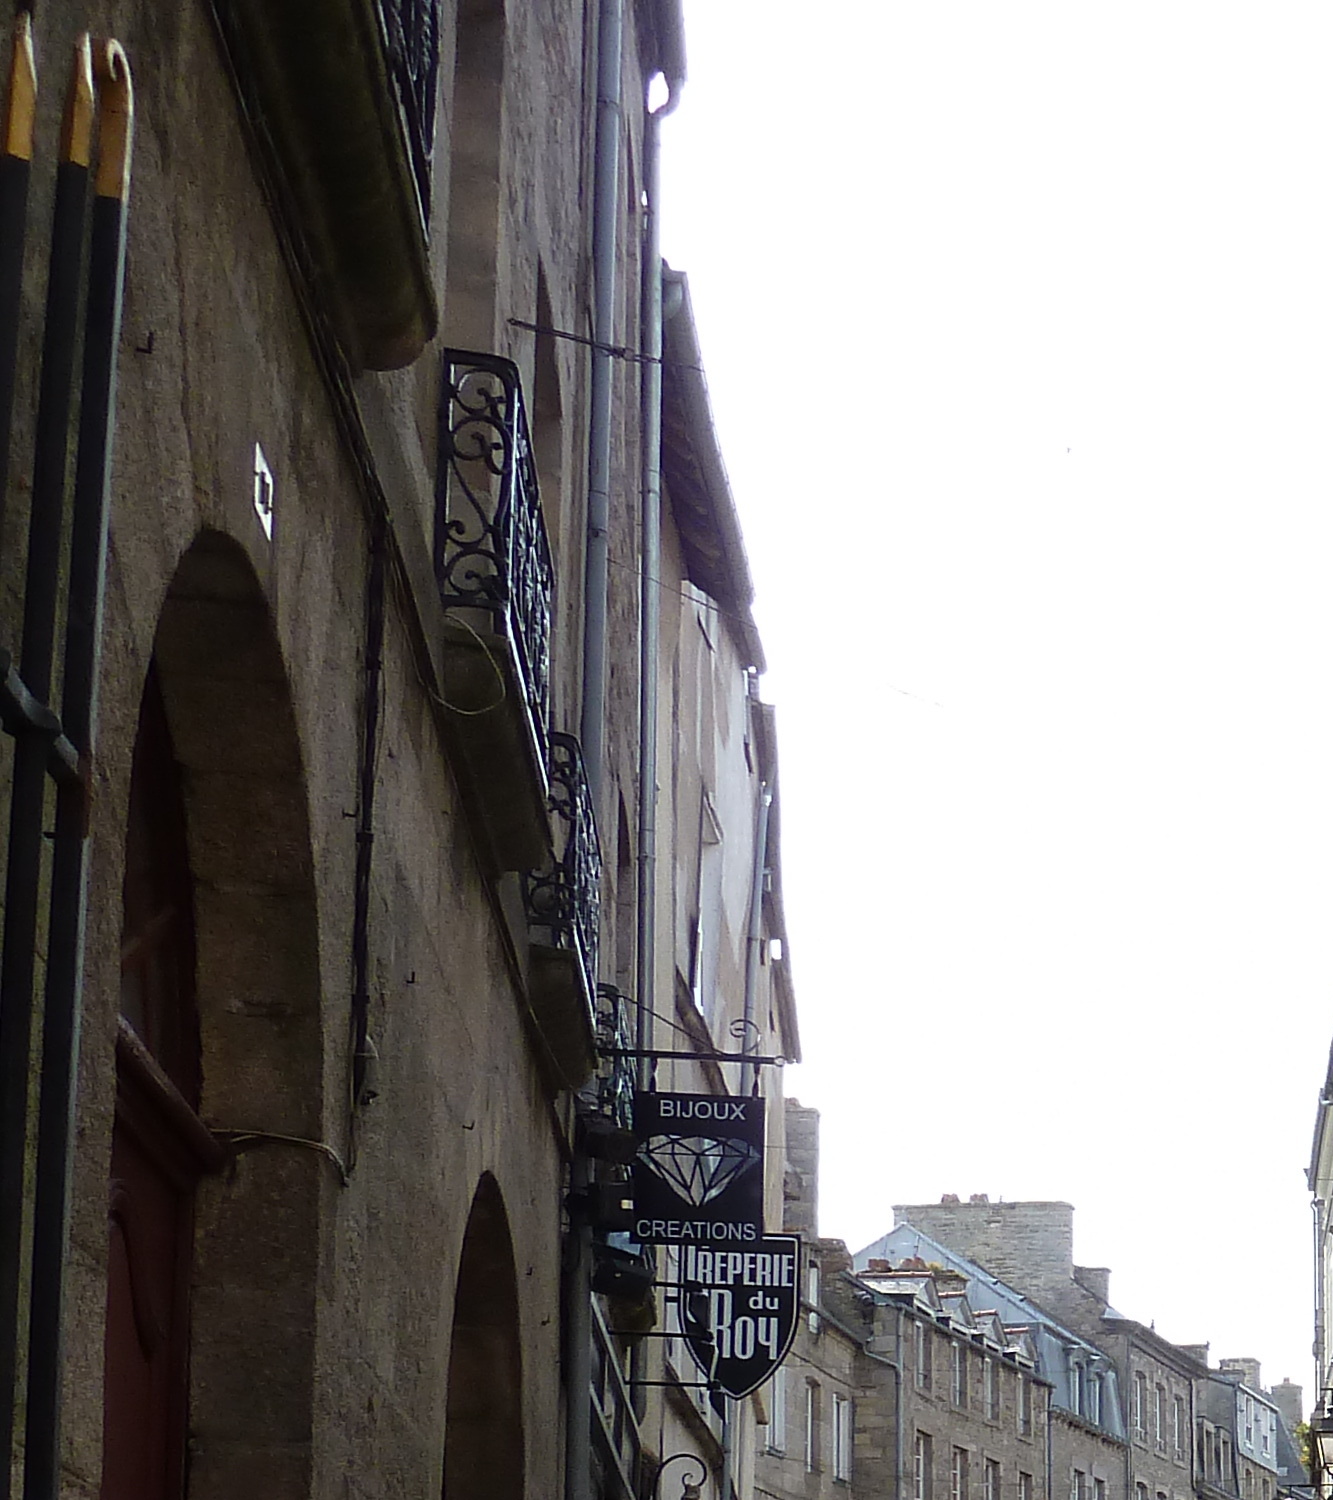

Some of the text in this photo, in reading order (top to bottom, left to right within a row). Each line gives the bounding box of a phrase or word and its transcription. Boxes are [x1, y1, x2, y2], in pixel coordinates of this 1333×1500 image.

[659, 1100, 747, 1121] BIJOUX
[636, 1219, 757, 1241] CREATIONS
[748, 1290, 779, 1310] du
